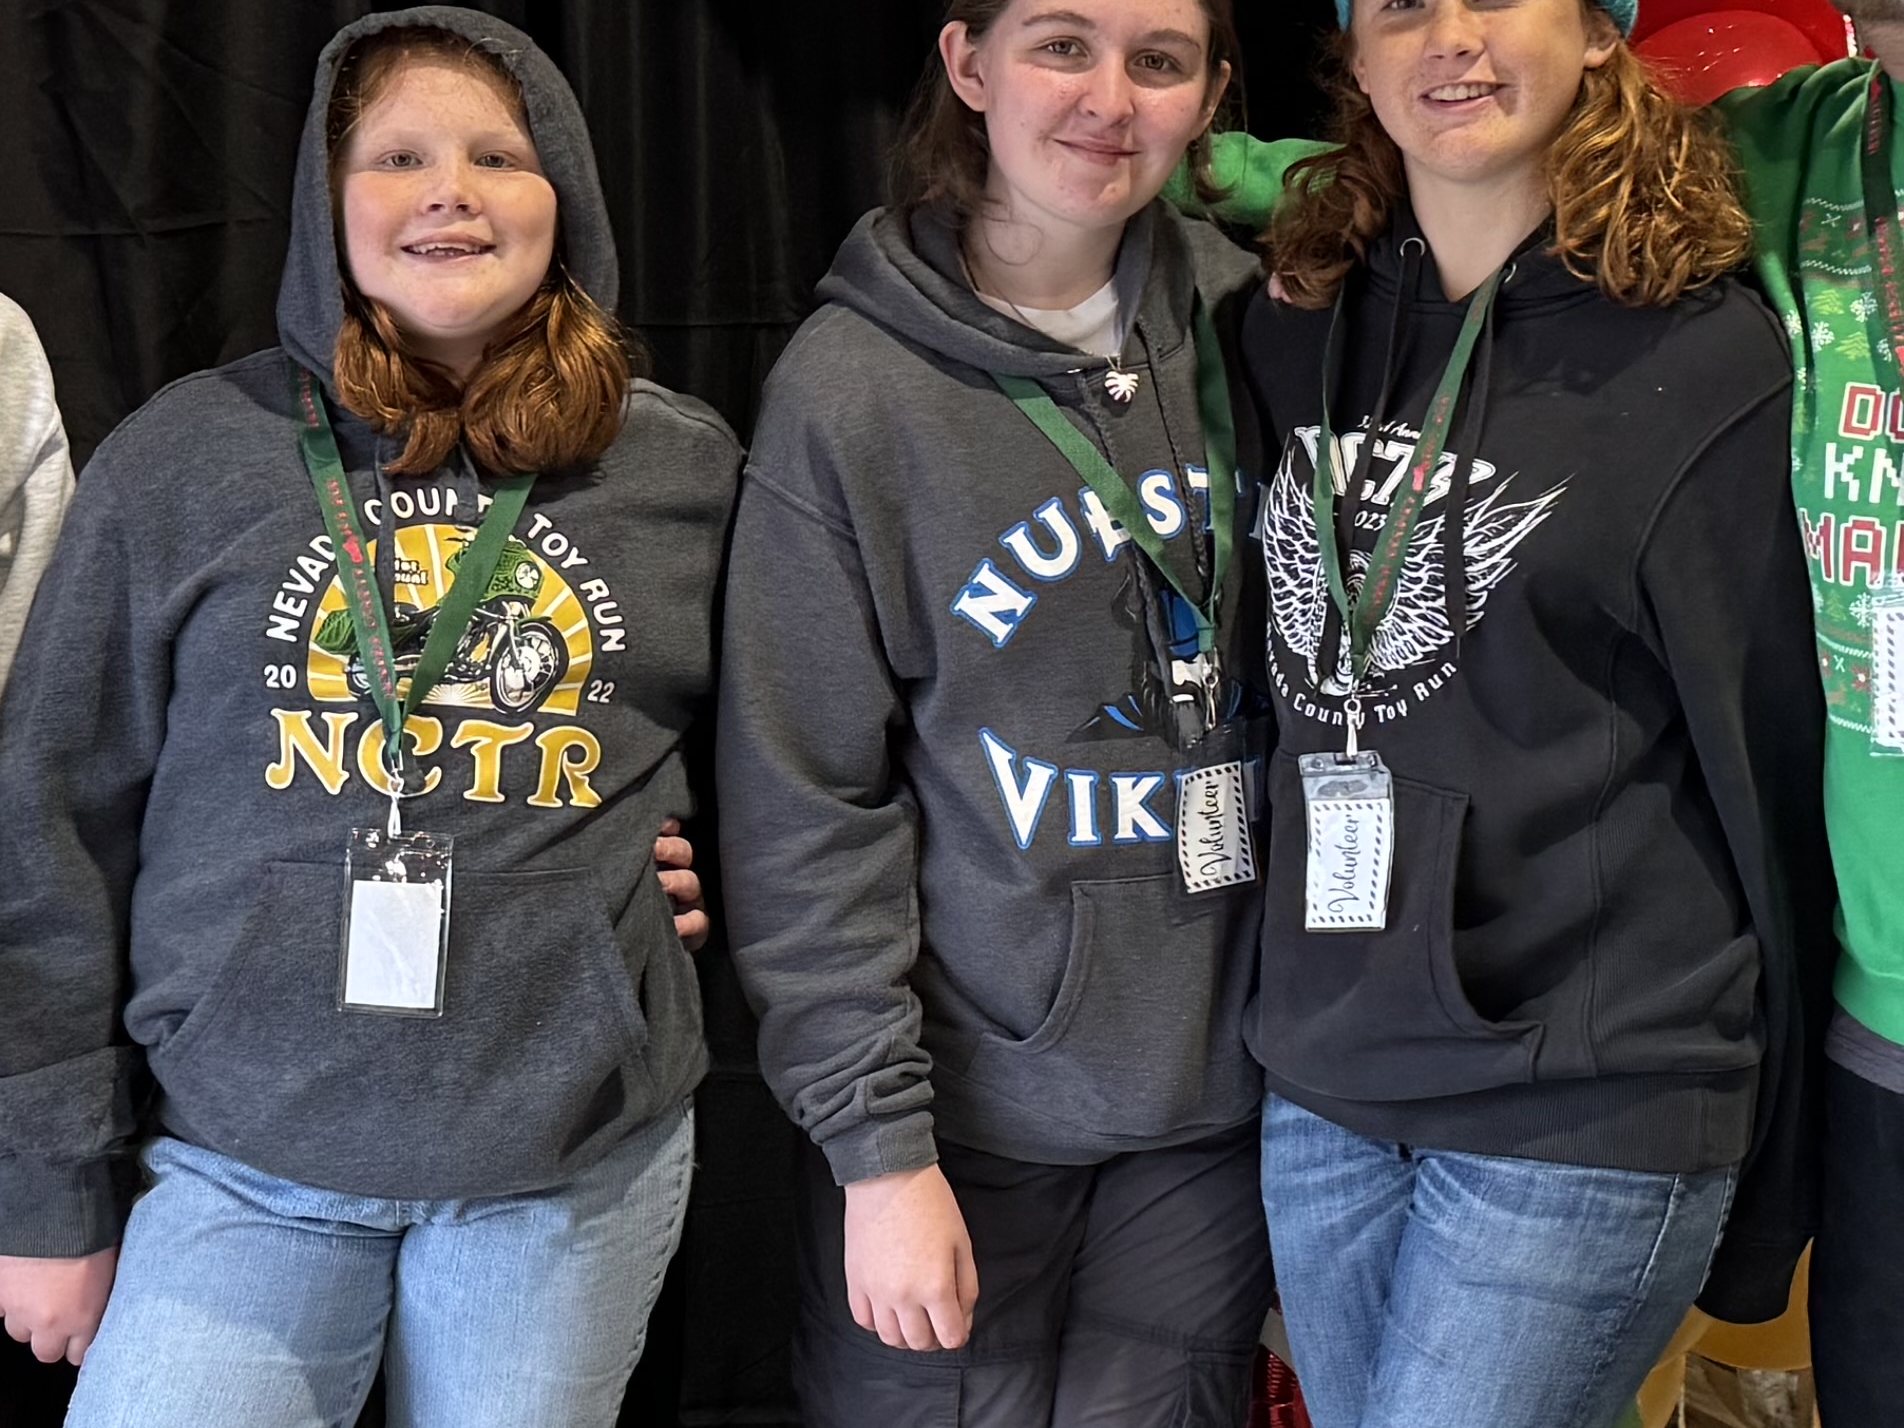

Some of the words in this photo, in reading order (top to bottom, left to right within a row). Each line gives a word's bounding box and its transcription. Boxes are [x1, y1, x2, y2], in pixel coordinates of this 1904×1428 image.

[1354, 510, 1389, 531] 023
[266, 535, 336, 643] NEVAD
[528, 512, 589, 570] TOY
[580, 578, 627, 653] RUN
[264, 664, 297, 689] 20
[587, 679, 616, 704] 22
[1293, 693, 1365, 730] Couny
[1374, 699, 1408, 723] Toy
[1413, 661, 1457, 701] Run
[264, 708, 602, 808] NCTR
[1197, 779, 1232, 877] Volunteer
[1327, 814, 1361, 913] Volunteer
